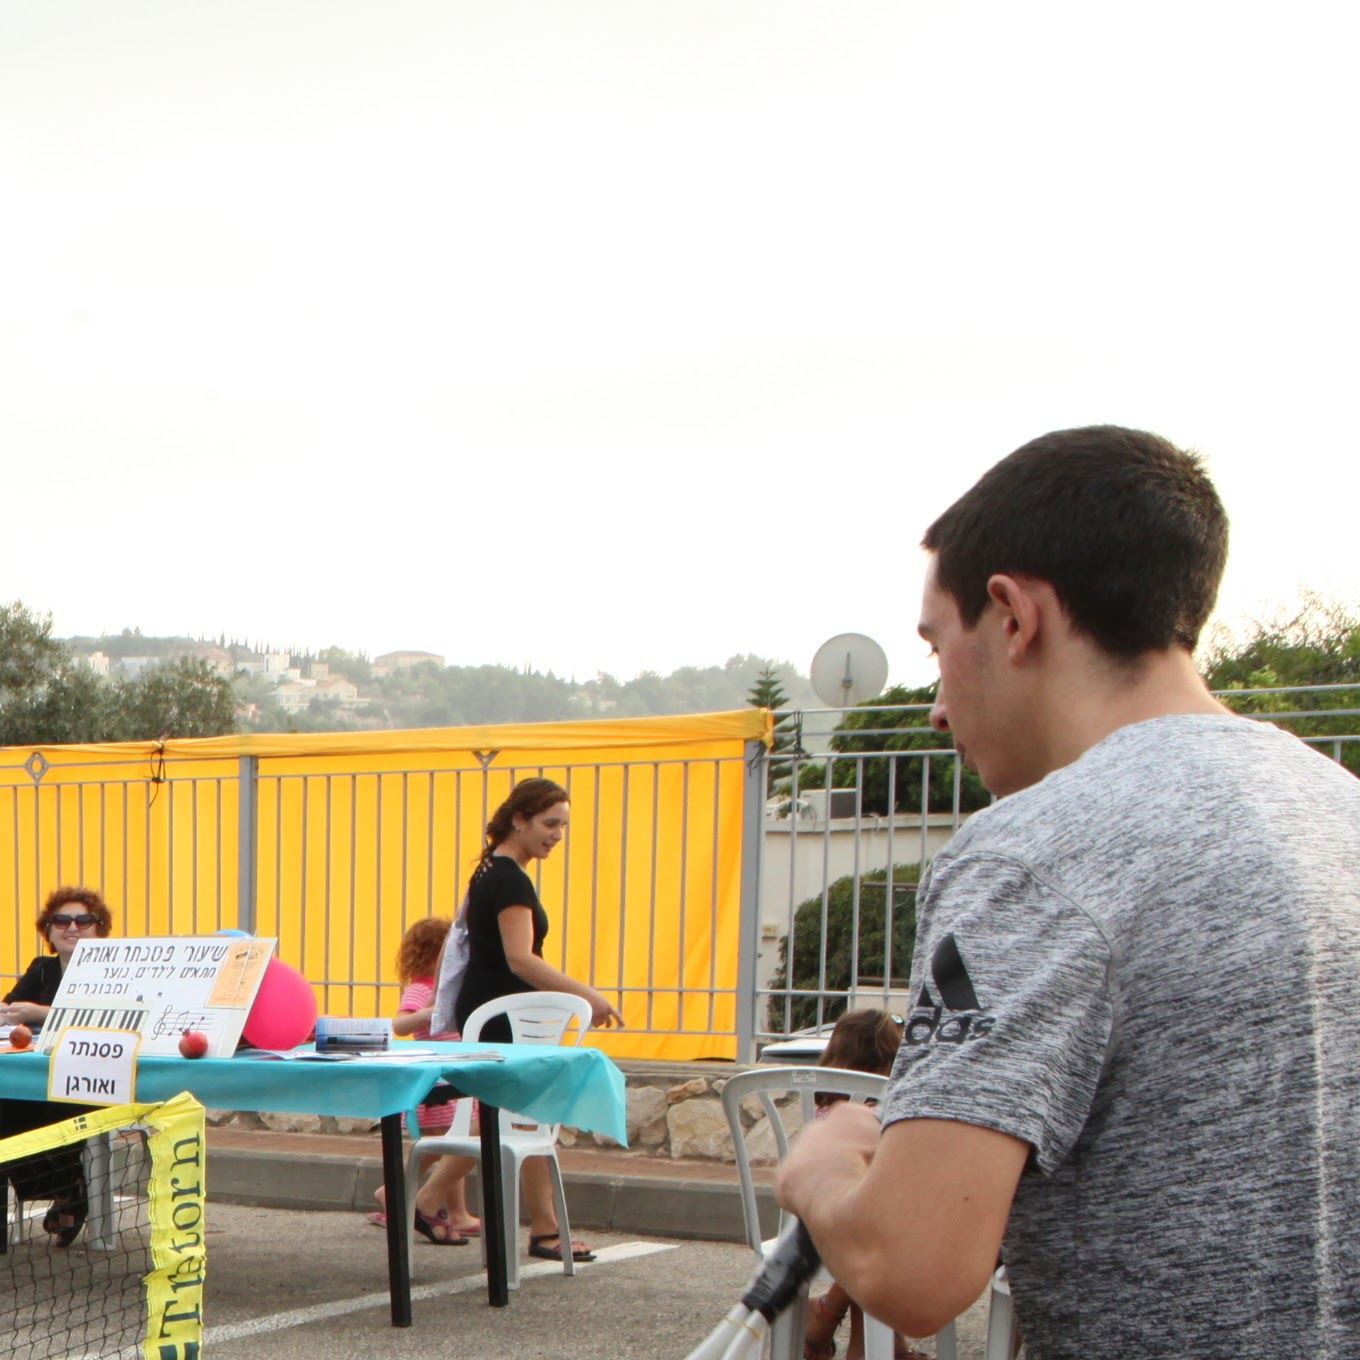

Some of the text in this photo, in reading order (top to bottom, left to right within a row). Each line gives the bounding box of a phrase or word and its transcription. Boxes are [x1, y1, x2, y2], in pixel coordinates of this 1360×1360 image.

[124, 945, 176, 963] פסנתר
[103, 967, 129, 979] נוער
[66, 983, 130, 995] ומבוגרים
[68, 1040, 123, 1058] פסנתר
[65, 1075, 115, 1096] ואורגן
[159, 1131, 201, 1340] Tretorn
